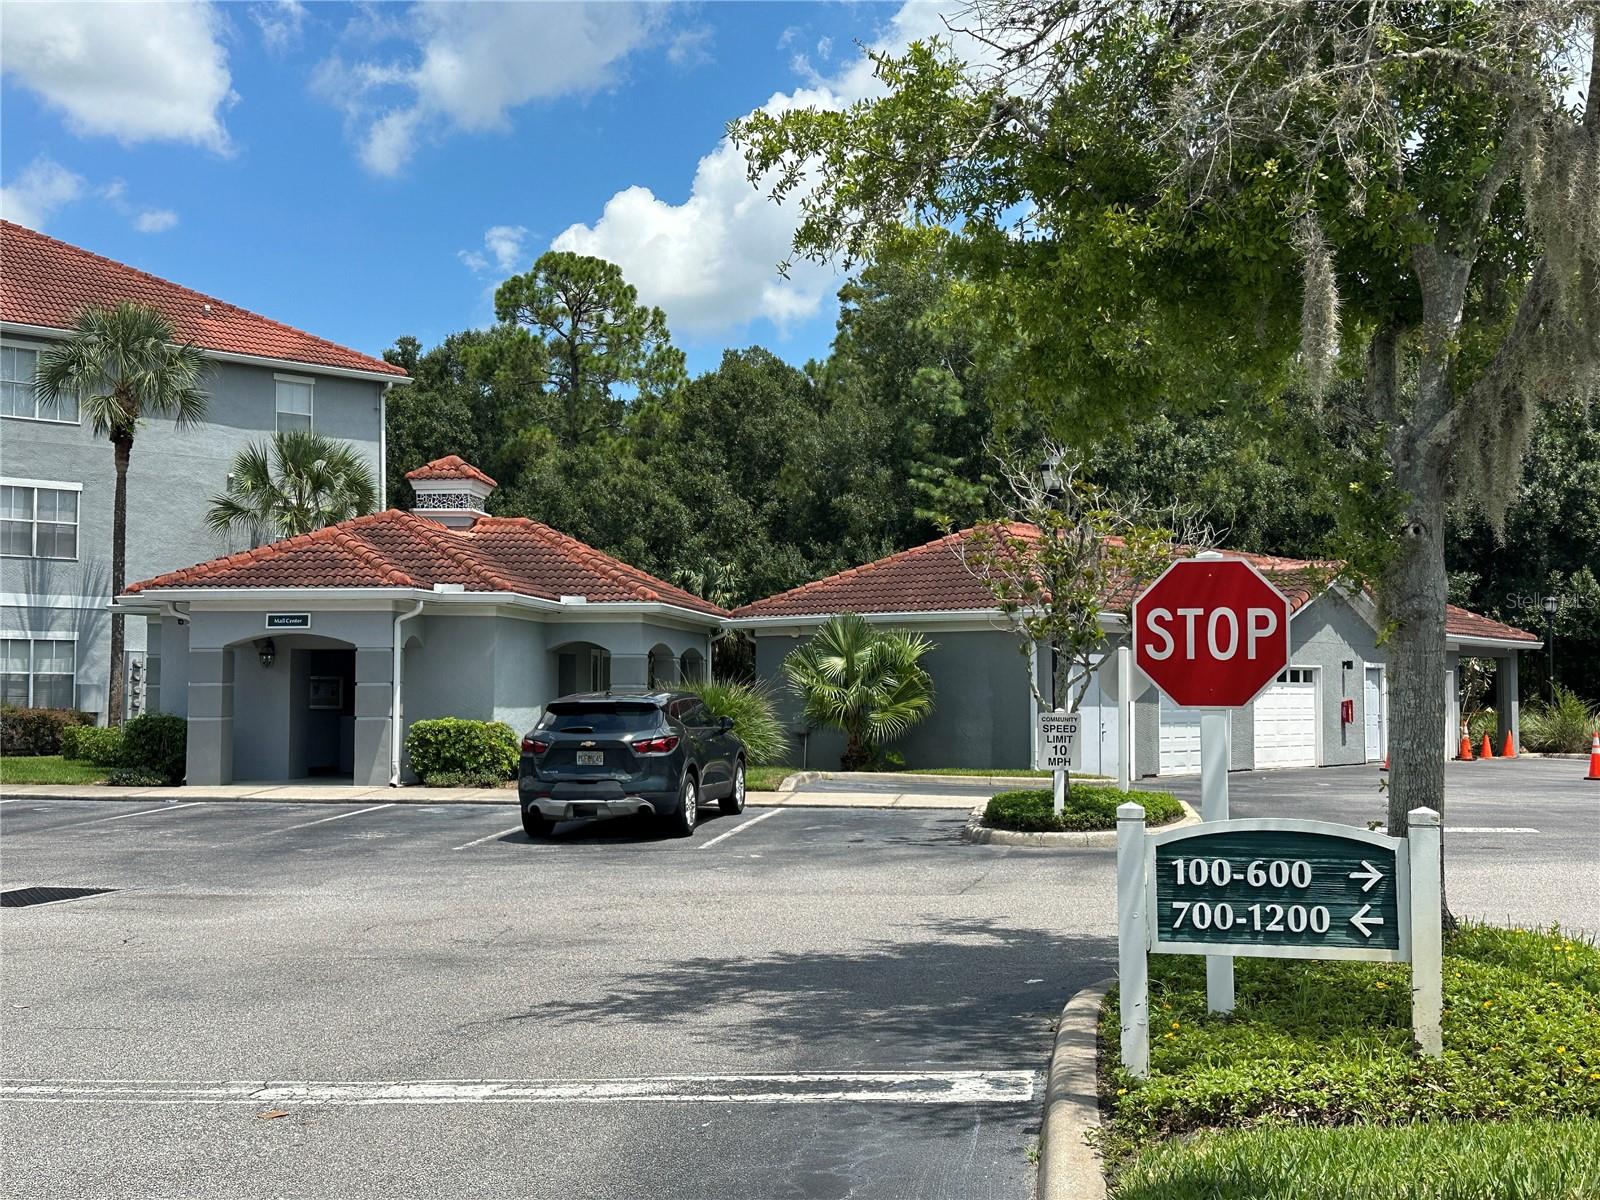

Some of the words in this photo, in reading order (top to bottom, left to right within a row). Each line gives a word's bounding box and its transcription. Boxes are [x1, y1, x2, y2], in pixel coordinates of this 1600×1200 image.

[1145, 607, 1277, 661] STOP
[1042, 724, 1077, 733] SPEED
[1046, 735, 1073, 743] LIMIT
[1052, 744, 1067, 756] 10
[1048, 757, 1071, 767] MPH
[1171, 858, 1312, 888] 100-600
[1172, 902, 1331, 933] 700-1200
